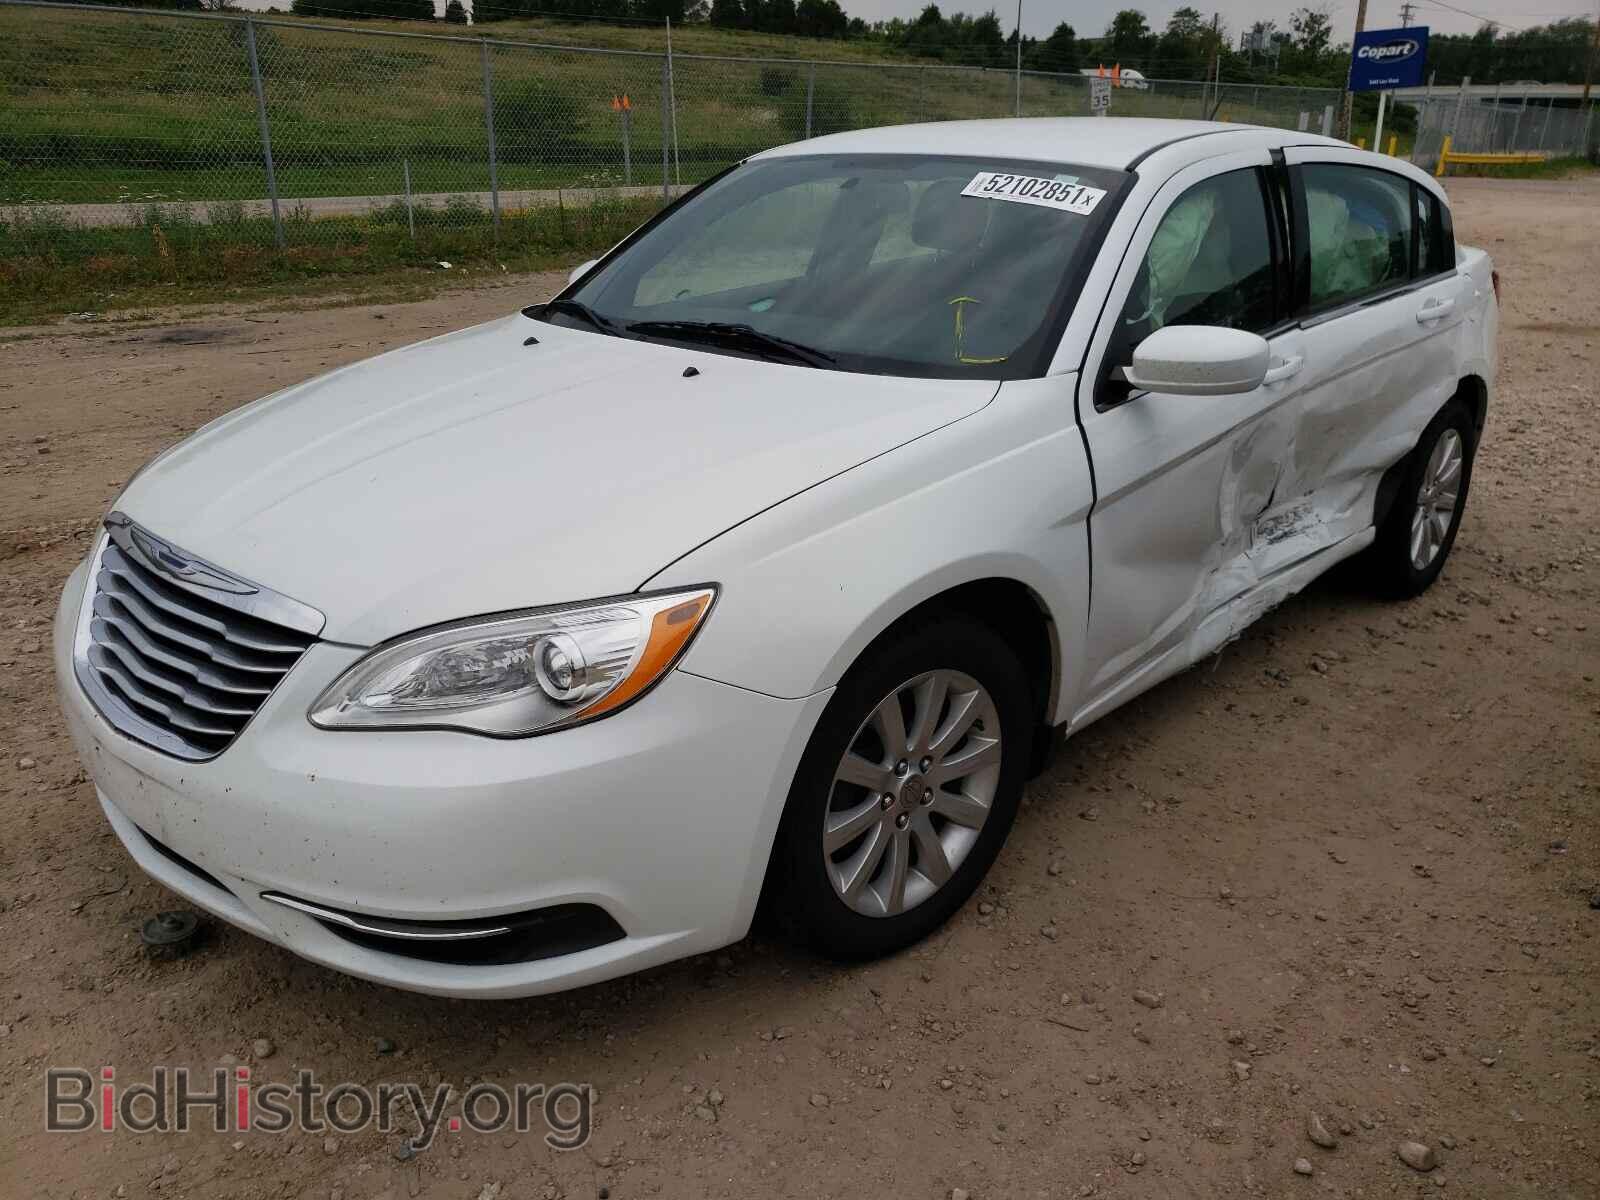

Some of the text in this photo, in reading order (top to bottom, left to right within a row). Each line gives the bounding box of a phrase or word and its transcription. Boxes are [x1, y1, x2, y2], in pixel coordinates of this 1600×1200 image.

[1358, 43, 1411, 60] Copart
[1094, 95, 1109, 107] 35
[983, 174, 1086, 205] 52102851
